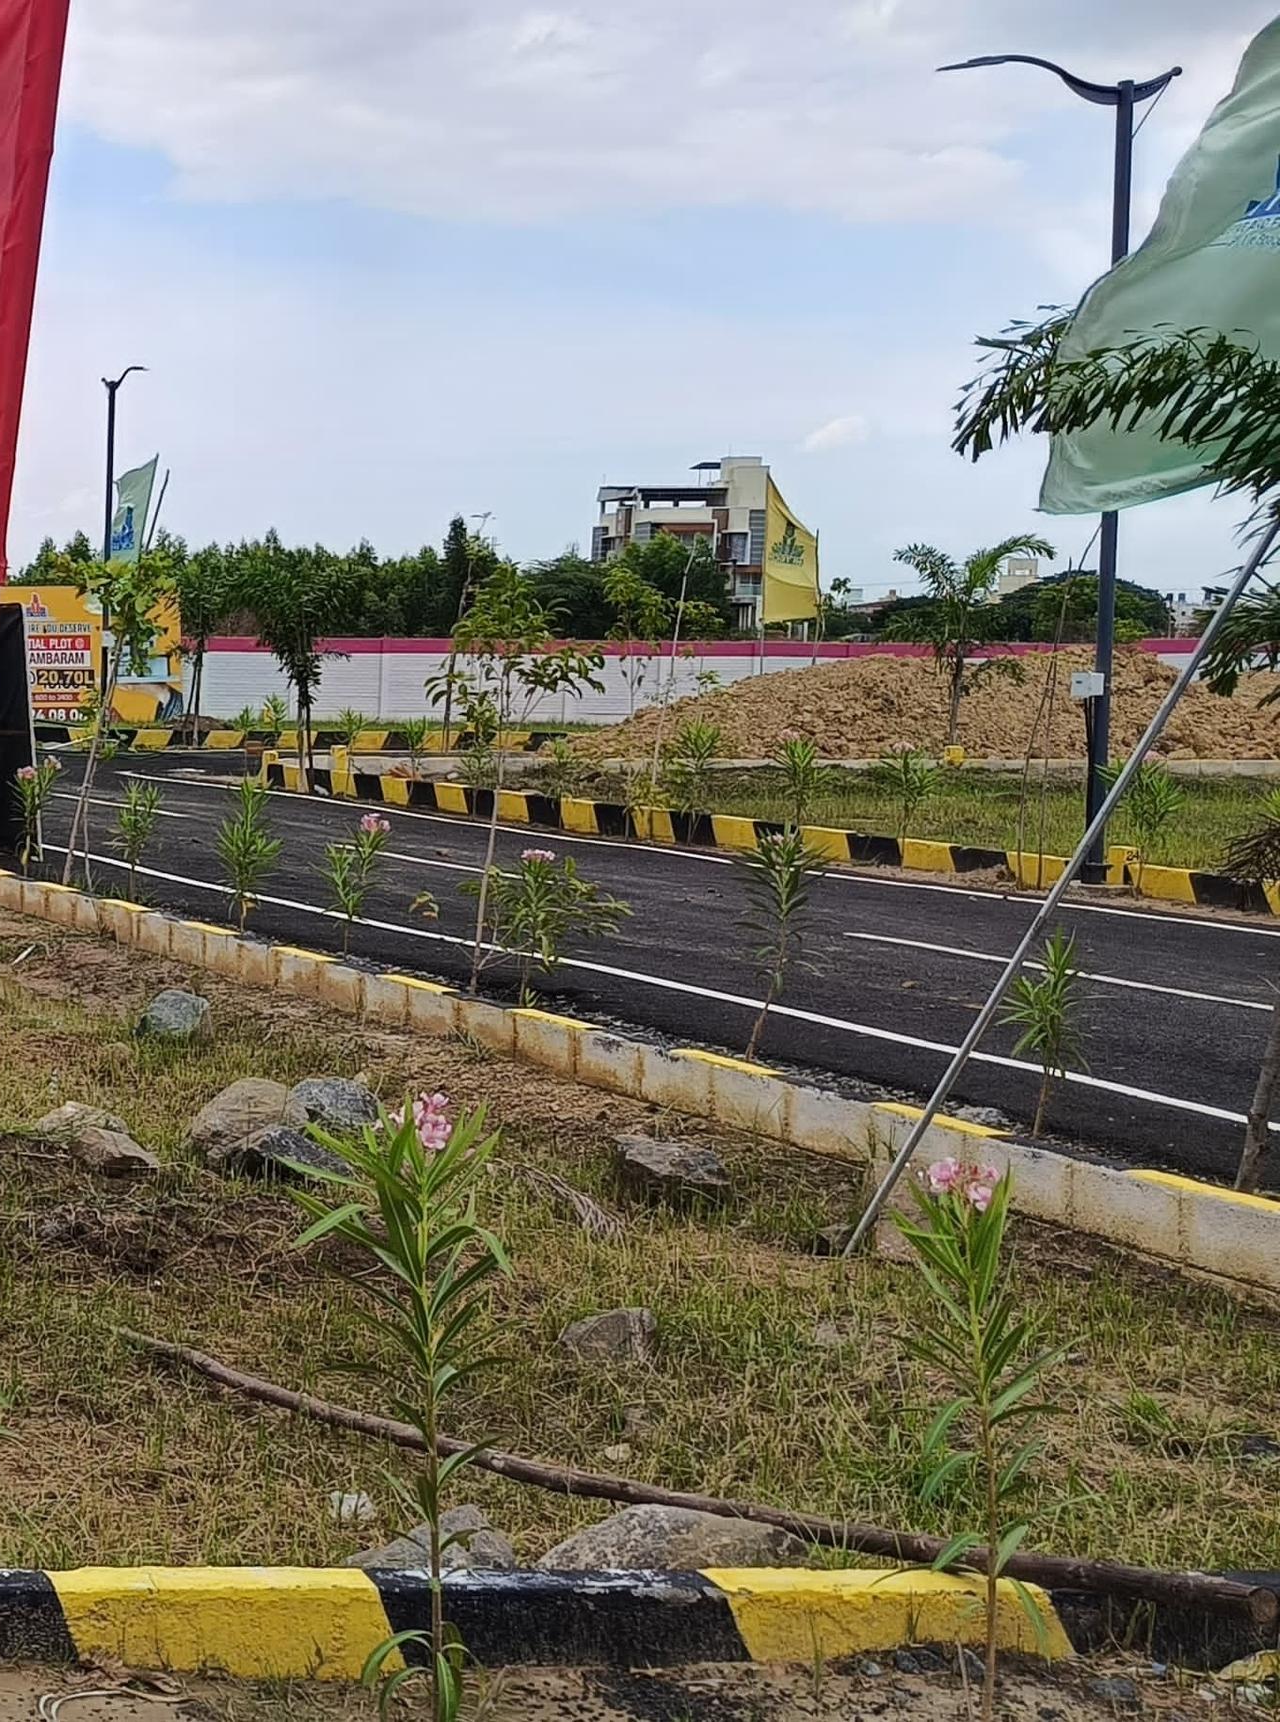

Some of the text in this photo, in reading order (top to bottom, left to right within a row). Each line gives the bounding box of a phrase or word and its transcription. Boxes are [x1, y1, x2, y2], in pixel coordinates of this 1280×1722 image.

[60, 623, 92, 633] DESERVE
[49, 638, 72, 649] PLOT
[38, 670, 94, 684] 20.70L
